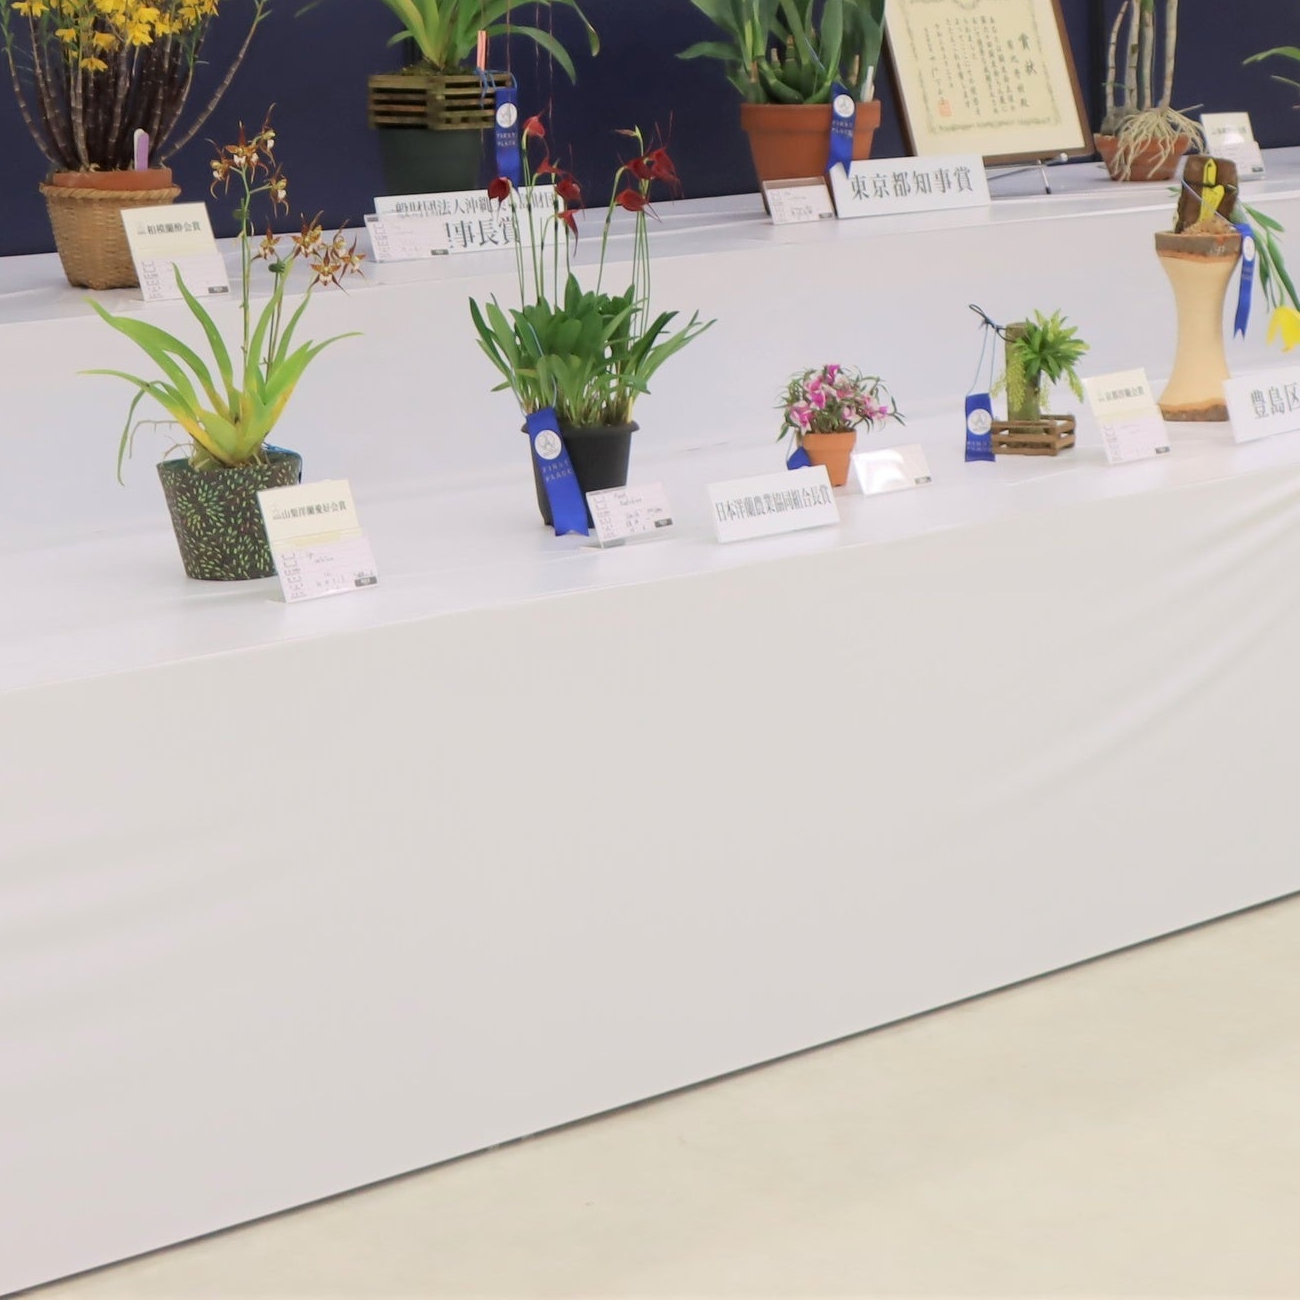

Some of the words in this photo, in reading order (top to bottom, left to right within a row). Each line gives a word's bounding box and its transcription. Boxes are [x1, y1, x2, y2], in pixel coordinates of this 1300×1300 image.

[850, 165, 974, 201] 東京都知事賞
[541, 458, 570, 474] FIRST
[545, 468, 574, 482] PLACE
